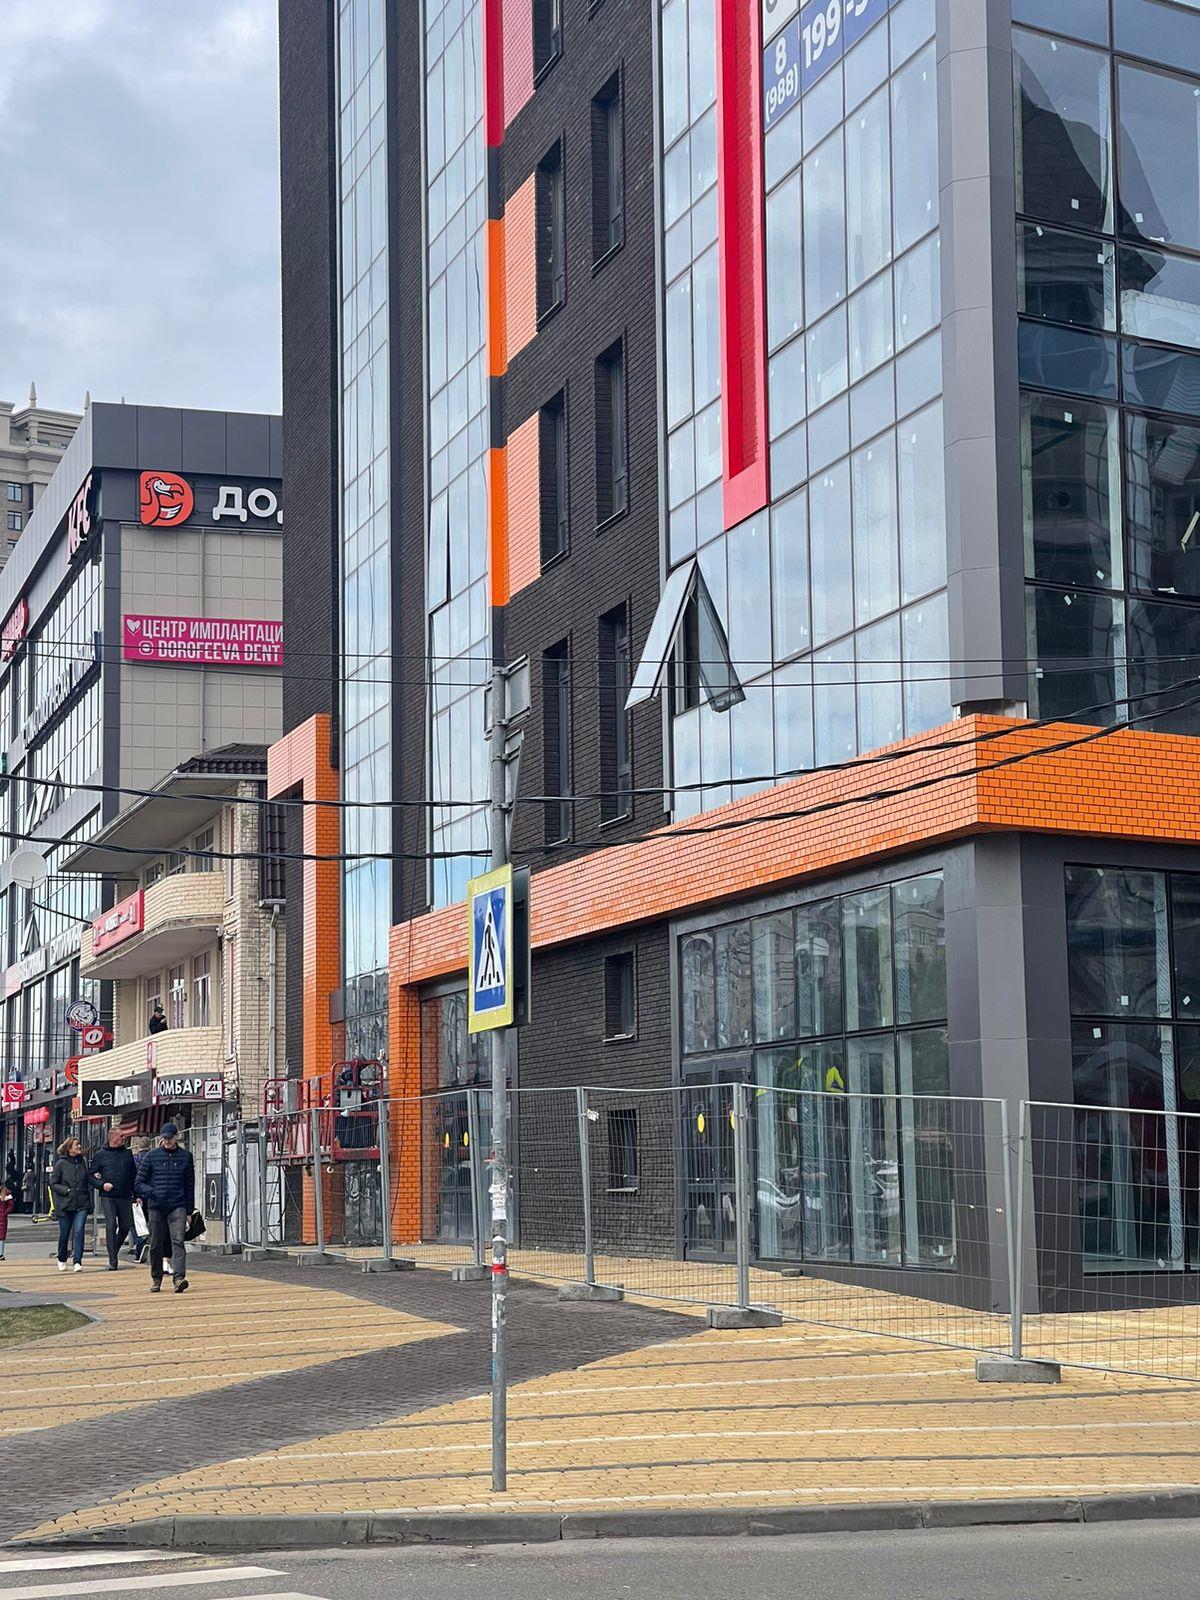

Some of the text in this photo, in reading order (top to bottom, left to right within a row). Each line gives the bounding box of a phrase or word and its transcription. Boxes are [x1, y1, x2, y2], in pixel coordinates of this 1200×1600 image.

[765, 0, 869, 123] 8 (988) 199-
[212, 486, 283, 524] ДО
[143, 619, 283, 643] ЦЕНТР ИМПЛАНТАЦИ
[158, 640, 280, 662] DOROFEEVA DENT
[157, 1078, 211, 1096] ОМБАР
